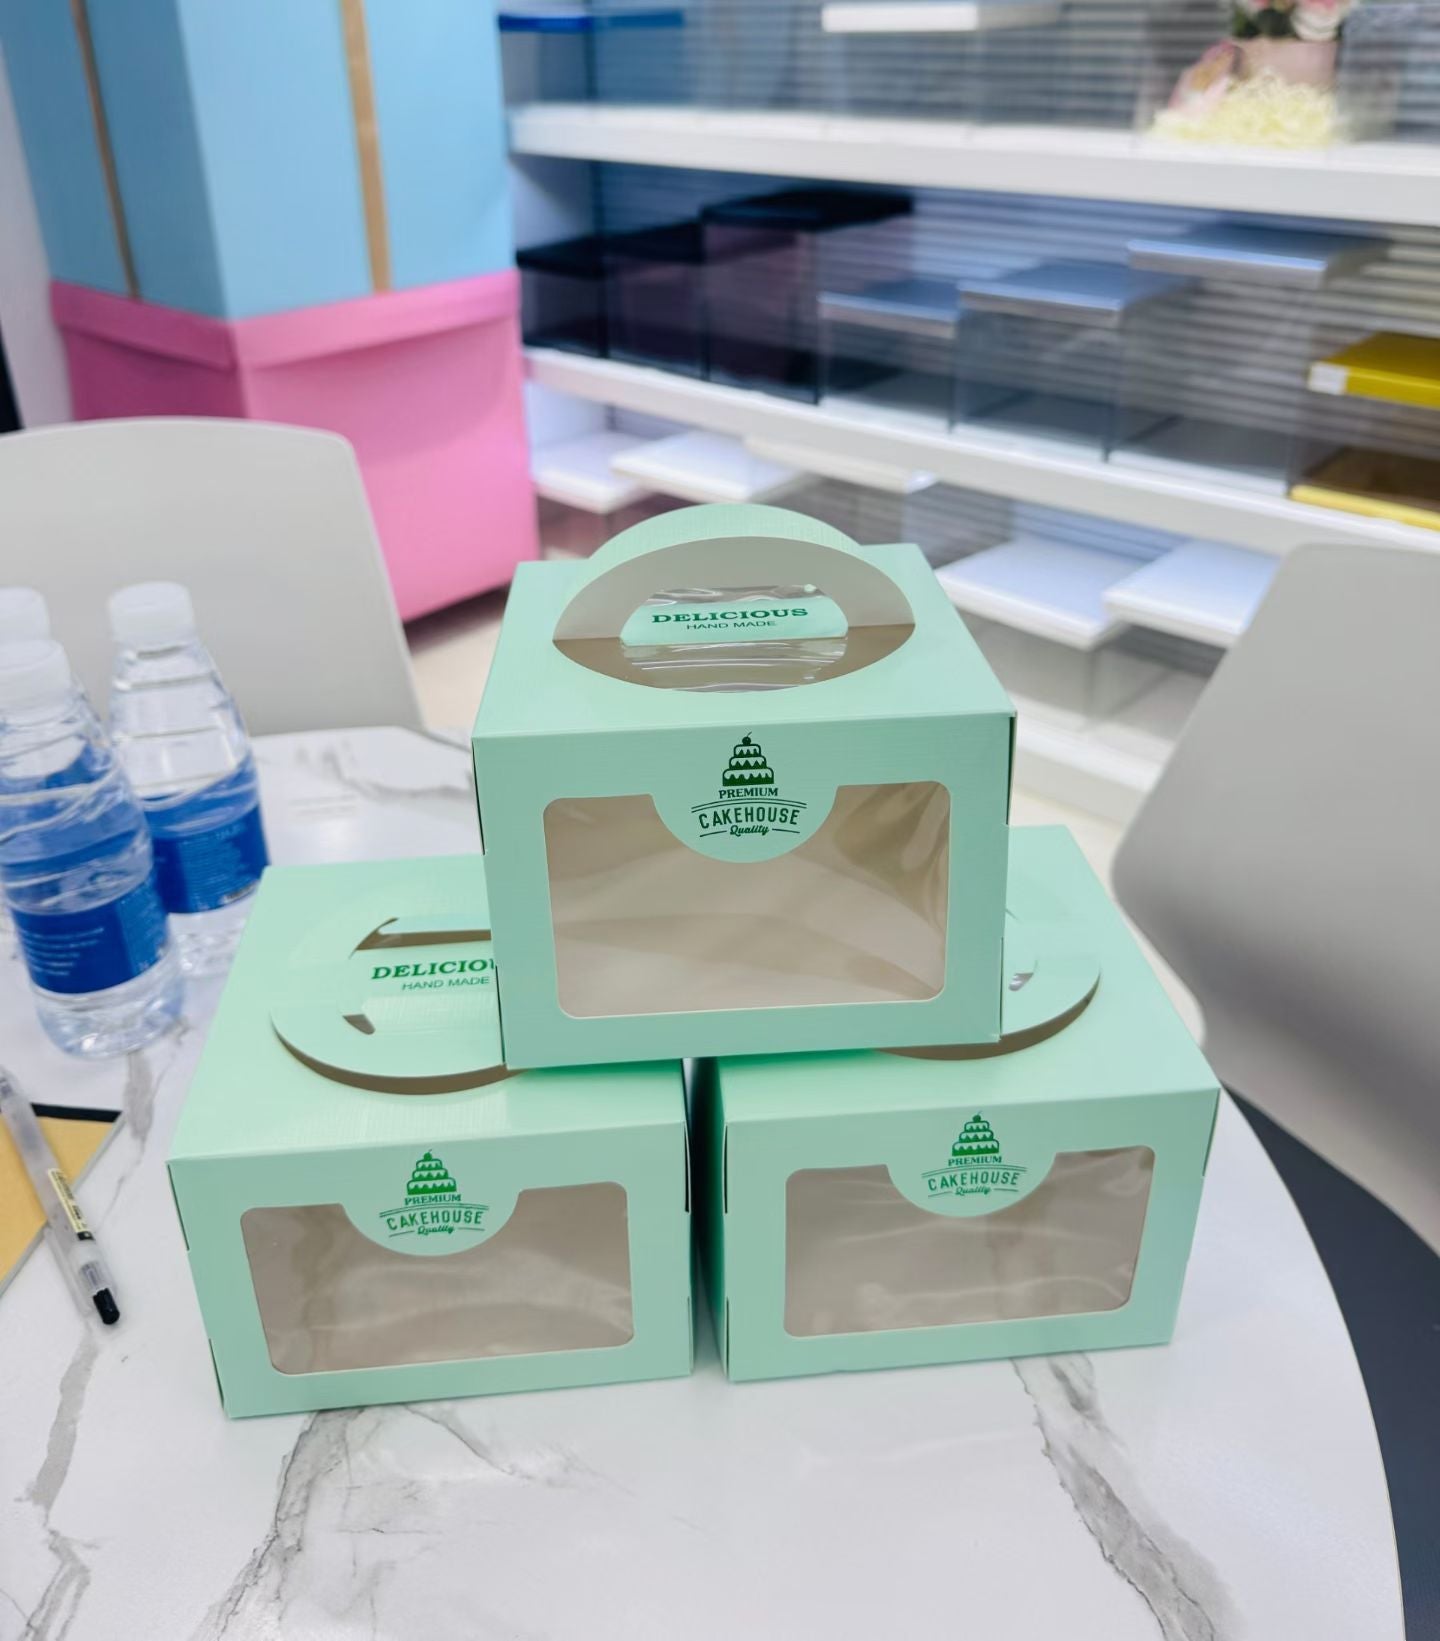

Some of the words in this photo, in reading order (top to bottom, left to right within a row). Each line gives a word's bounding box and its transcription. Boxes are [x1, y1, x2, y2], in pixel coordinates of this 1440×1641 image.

[652, 608, 808, 623] DELICIOUS
[686, 622, 729, 630] HAND
[733, 620, 776, 629] MADE
[718, 787, 778, 799] PREMIUM
[698, 806, 800, 829] CAKEHOUSE
[730, 824, 769, 837] Quality
[401, 979, 444, 991] HAND
[448, 976, 490, 987] MADE
[948, 1155, 1002, 1167] PREMIUM
[927, 1171, 1020, 1191] CAKEHOUSE
[955, 1186, 992, 1196] Quality
[404, 1193, 461, 1206] PREMIUM
[386, 1210, 484, 1231] CAKEHOUSE
[417, 1224, 455, 1236] Quality
